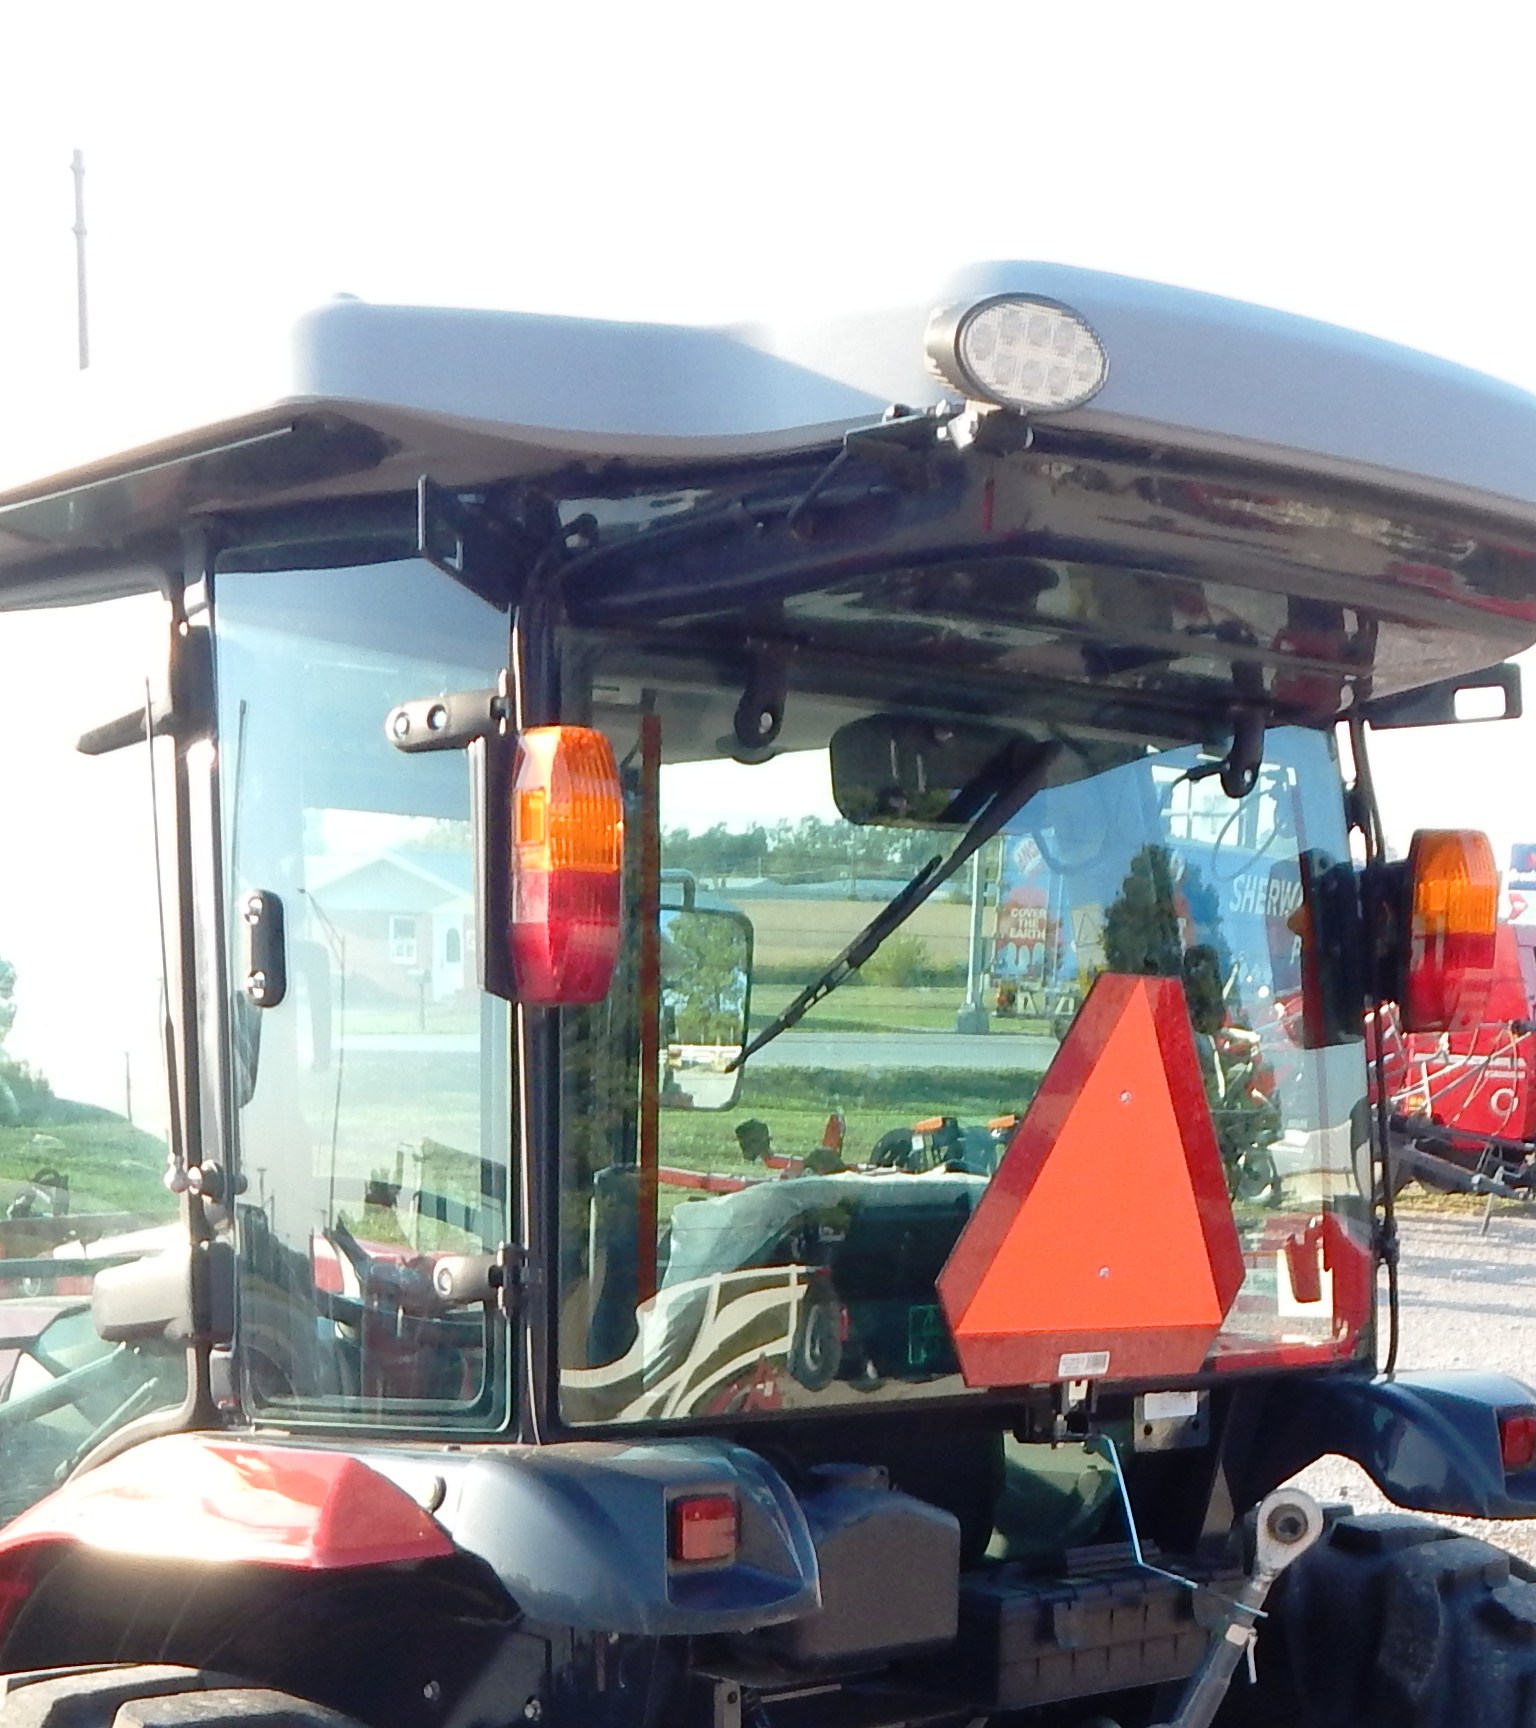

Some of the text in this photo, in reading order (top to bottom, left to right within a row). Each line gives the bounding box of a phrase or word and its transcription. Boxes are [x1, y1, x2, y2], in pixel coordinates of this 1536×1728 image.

[1011, 908, 1047, 919] COVER
[1018, 918, 1037, 929] THE
[1009, 928, 1046, 940] EARTH
